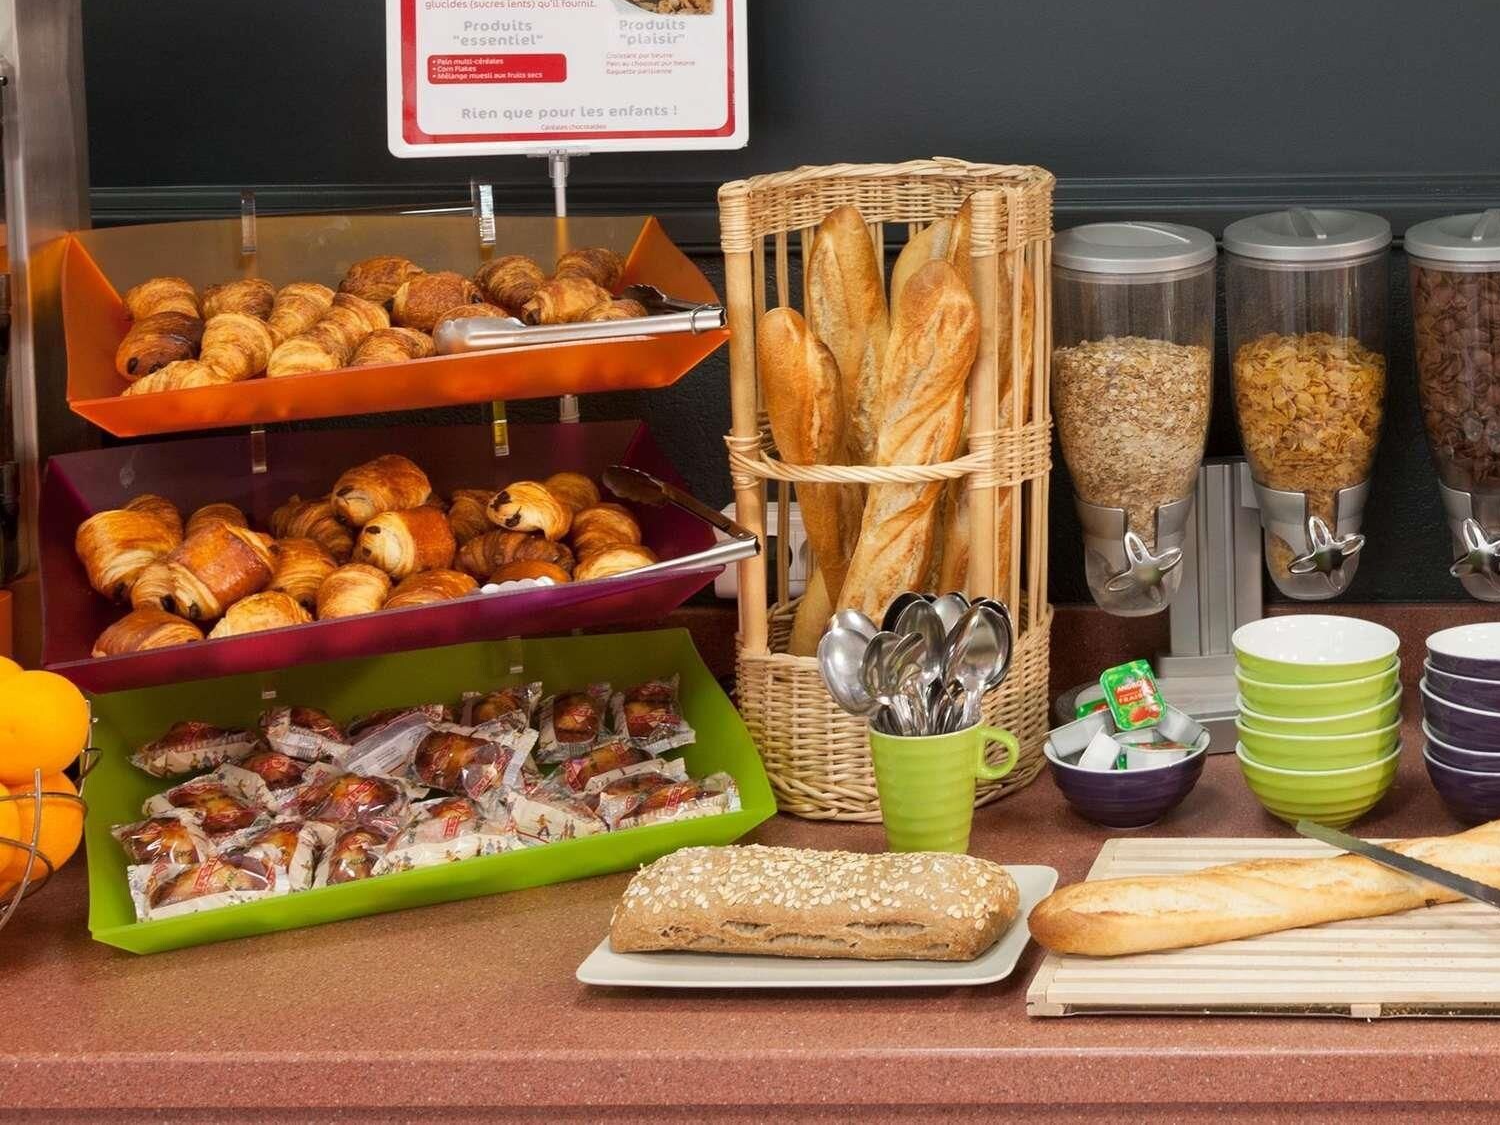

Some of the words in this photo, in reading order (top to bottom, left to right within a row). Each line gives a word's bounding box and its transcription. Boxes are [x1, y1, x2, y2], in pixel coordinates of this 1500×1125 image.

[425, 0, 467, 10] glucides
[470, 0, 505, 9] (sucres
[507, 0, 535, 9] lents)
[538, 0, 559, 9] qu'il
[561, 0, 597, 8] fournit.
[464, 20, 532, 32] Produits
[619, 19, 687, 31] Produits
[453, 34, 544, 47] "essentiel"
[620, 34, 686, 46] "plaisir"
[437, 72, 468, 81] Mélange
[461, 108, 497, 119] Rien
[504, 109, 533, 120] que
[538, 108, 576, 120] pour
[581, 106, 604, 117] les
[609, 105, 668, 117] enfants
